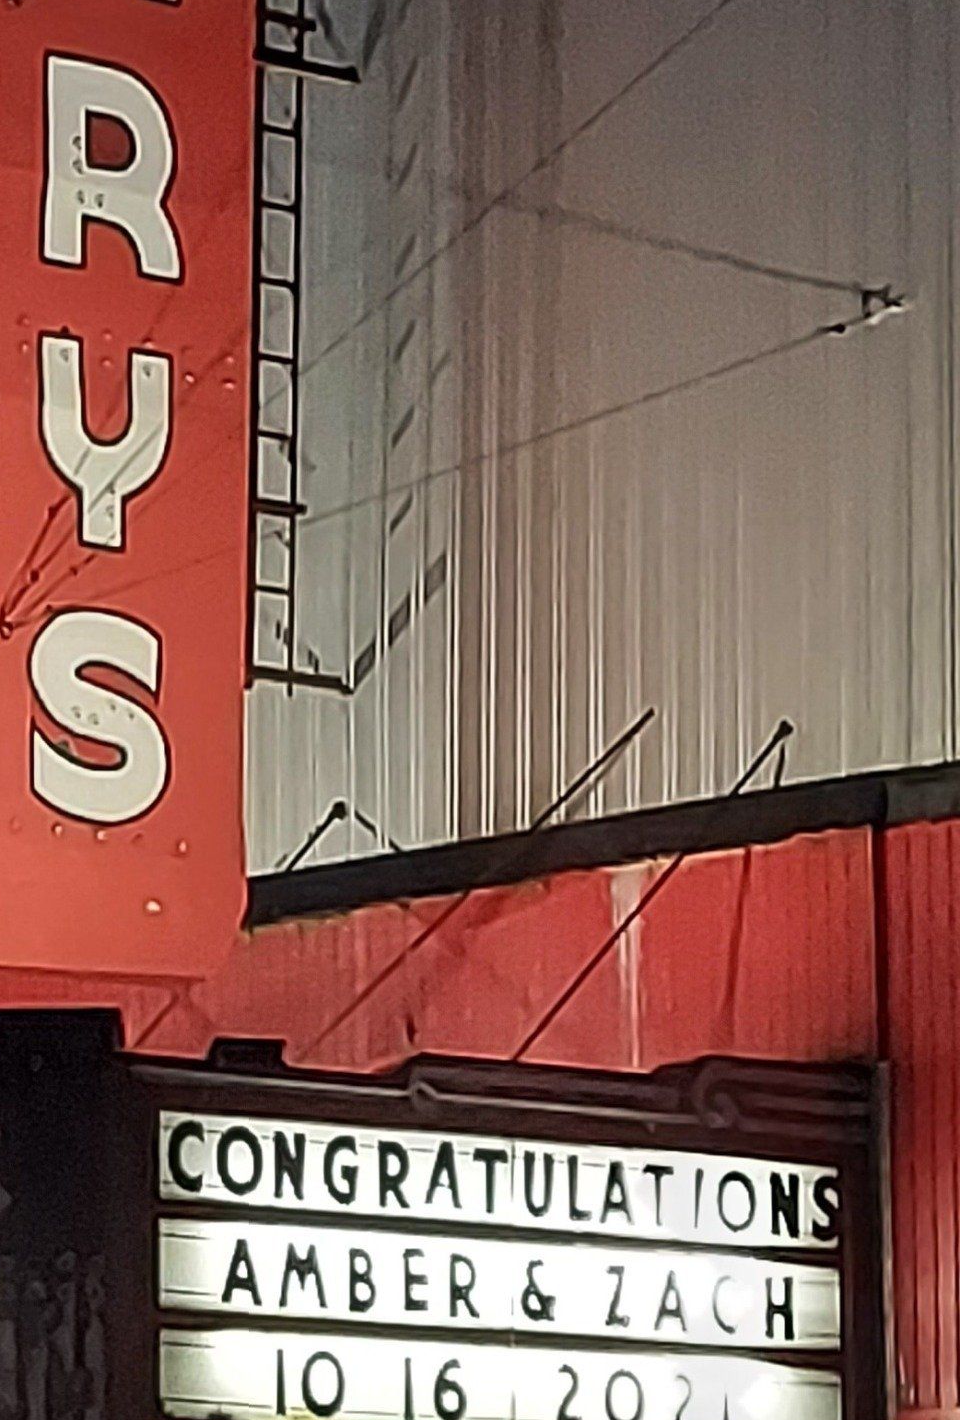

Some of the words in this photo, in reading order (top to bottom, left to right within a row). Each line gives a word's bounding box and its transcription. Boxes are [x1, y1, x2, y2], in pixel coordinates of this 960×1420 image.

[167, 1119, 841, 1241] CONGRATULATIONS
[221, 1238, 481, 1320] AMBER
[521, 1259, 556, 1321] &
[606, 1265, 795, 1341] ZACH
[275, 1348, 345, 1418] 10
